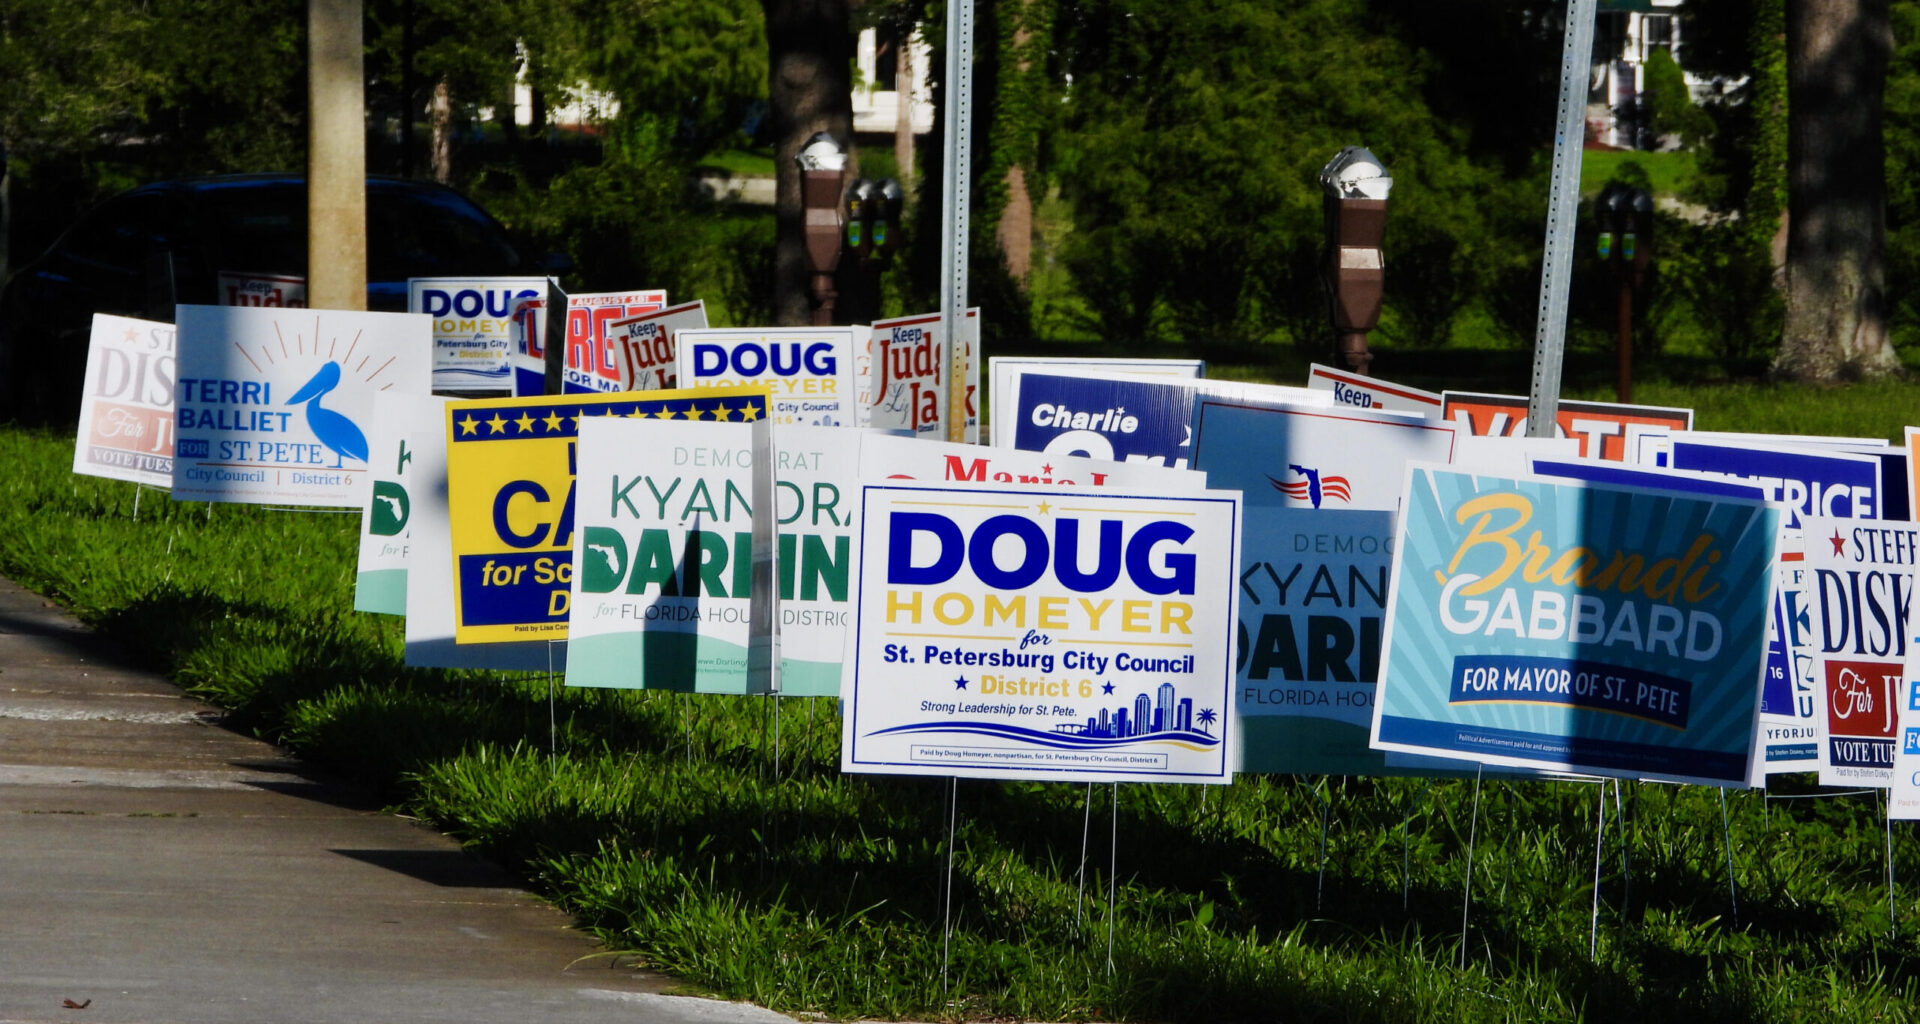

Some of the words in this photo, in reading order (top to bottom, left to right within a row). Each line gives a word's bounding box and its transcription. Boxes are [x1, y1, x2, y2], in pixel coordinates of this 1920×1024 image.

[423, 289, 540, 318] DOU
[628, 322, 656, 338] Keep
[892, 327, 922, 344] Keep
[619, 324, 676, 390] Jud
[693, 342, 837, 377] DOUG
[179, 379, 270, 405] TERRI
[1334, 381, 1372, 408] Keep
[777, 402, 799, 413] City
[802, 402, 839, 411] Council
[1031, 403, 1139, 433] Charlie
[178, 408, 292, 432] BALLIET
[93, 450, 132, 467] VOTE
[179, 441, 209, 456] FOR
[673, 447, 824, 471] DEMORAT
[186, 468, 212, 487] City
[215, 469, 265, 483] Council
[292, 471, 340, 486] District
[344, 474, 353, 486] 6
[887, 511, 1197, 596] DOUG
[1435, 493, 1721, 605] Brandi
[482, 561, 527, 587] for
[593, 602, 618, 620] for
[621, 604, 702, 623] FLORIDA
[885, 590, 1194, 635] HOMEYER
[1439, 573, 1723, 662] GABBARD
[514, 625, 529, 633] Paid
[530, 625, 539, 633] by
[1020, 629, 1053, 650] for
[883, 644, 915, 664] St.
[924, 645, 1055, 673] Petersburg
[1063, 651, 1108, 676] City
[1115, 653, 1195, 674] Council
[1771, 666, 1784, 679] 16
[980, 674, 1070, 698] District
[1078, 679, 1093, 698] 6
[1244, 688, 1329, 706] FLORIDA
[1462, 667, 1499, 692] FOR
[1503, 667, 1572, 694] MAYOR
[1575, 672, 1600, 697] OF
[1603, 676, 1630, 704] ST.
[1636, 682, 1680, 715] PETE
[1832, 667, 1874, 720] For
[920, 700, 955, 715] Strong
[958, 702, 1016, 716] Leadership
[1018, 704, 1034, 715] for
[1036, 705, 1049, 716] St.
[1052, 705, 1078, 717] Pete.
[1458, 733, 1478, 741] Political
[1479, 736, 1514, 747] Advertisement
[1514, 741, 1525, 749] paid
[1543, 745, 1565, 753] approved
[1834, 741, 1870, 763] VOTE
[944, 750, 962, 758] Doug
[962, 751, 992, 759] Homeyer,
[993, 752, 1034, 760] nonpartisan,
[1055, 755, 1090, 763] Petersburg
